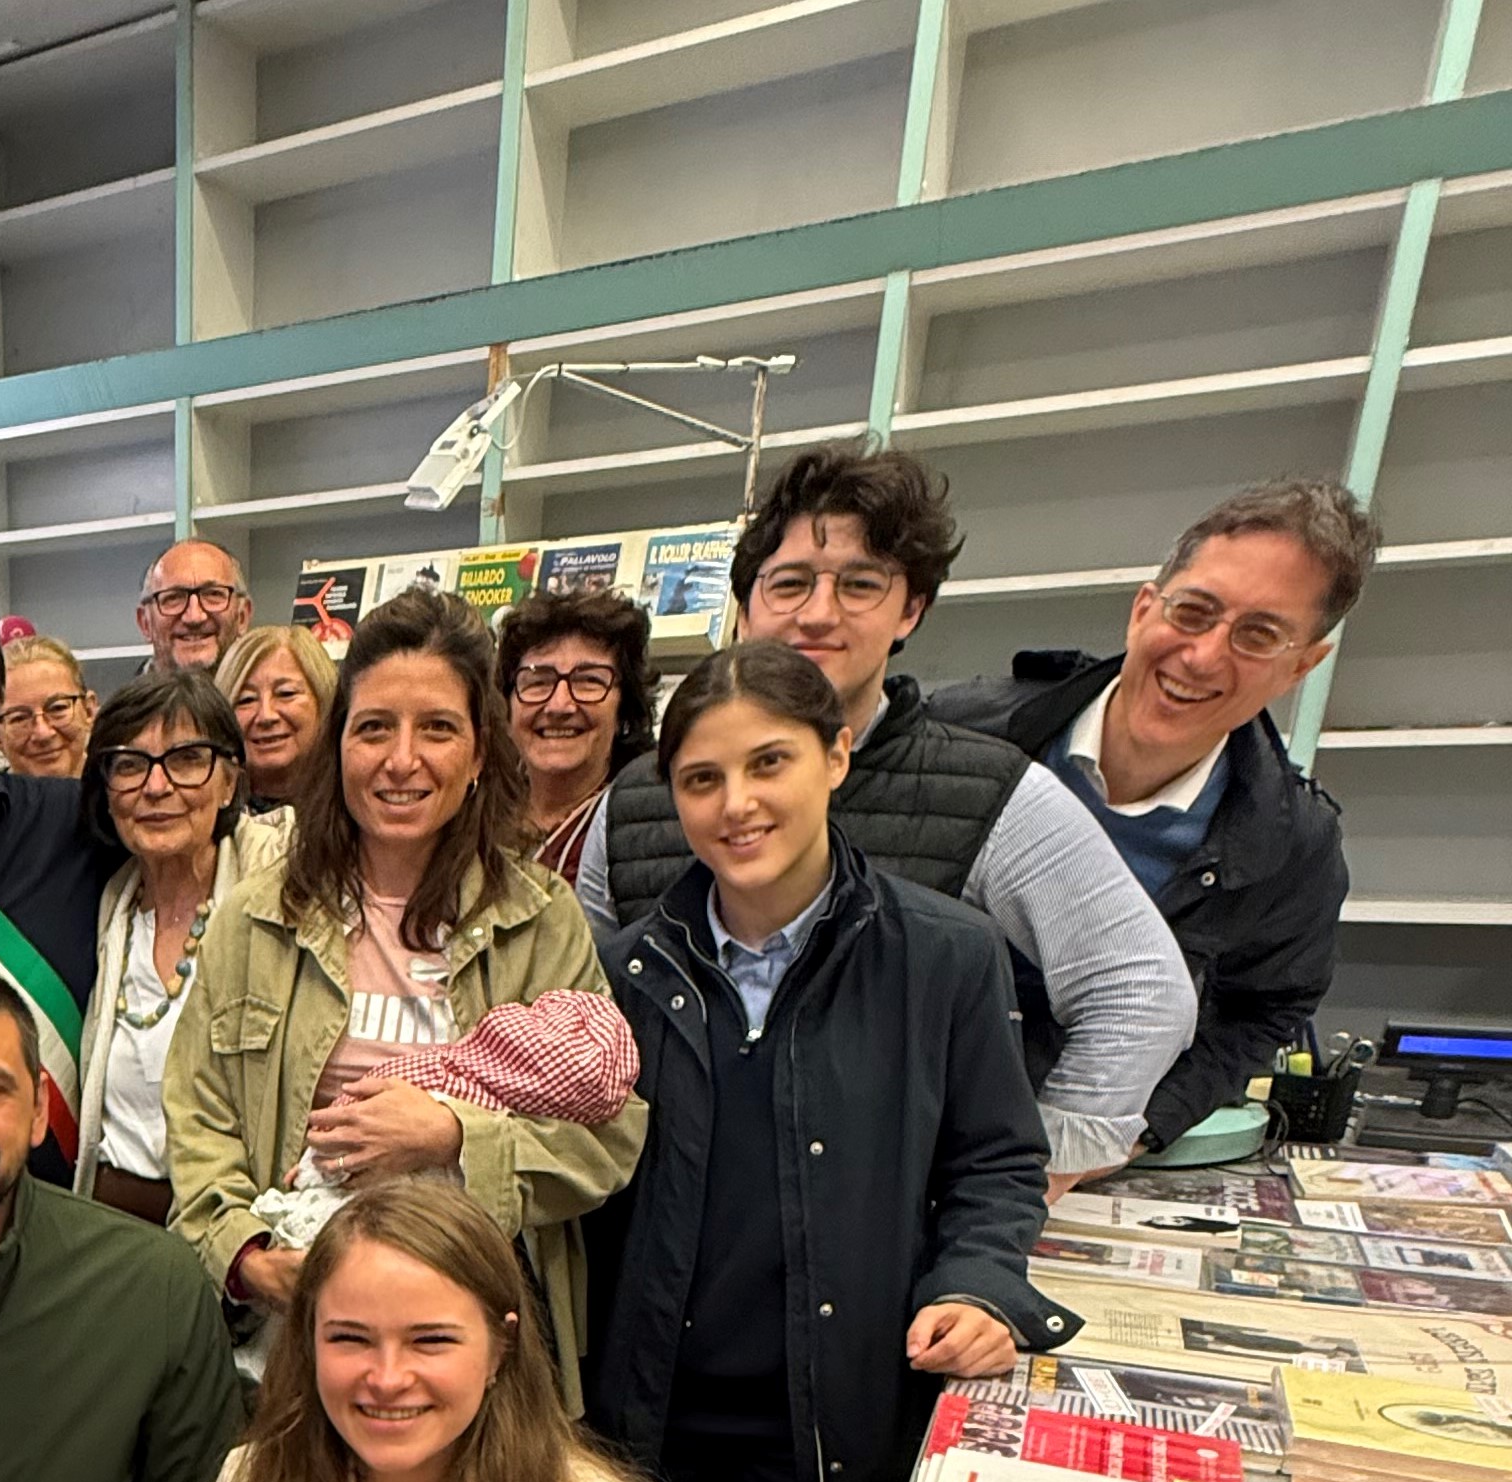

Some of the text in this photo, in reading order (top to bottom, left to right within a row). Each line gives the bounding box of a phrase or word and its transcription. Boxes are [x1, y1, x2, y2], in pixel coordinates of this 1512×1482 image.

[560, 552, 617, 566] PALLAVOLO
[459, 567, 506, 588] BILIARDO
[465, 586, 513, 606] SNOOKER
[348, 991, 460, 1045] UM
